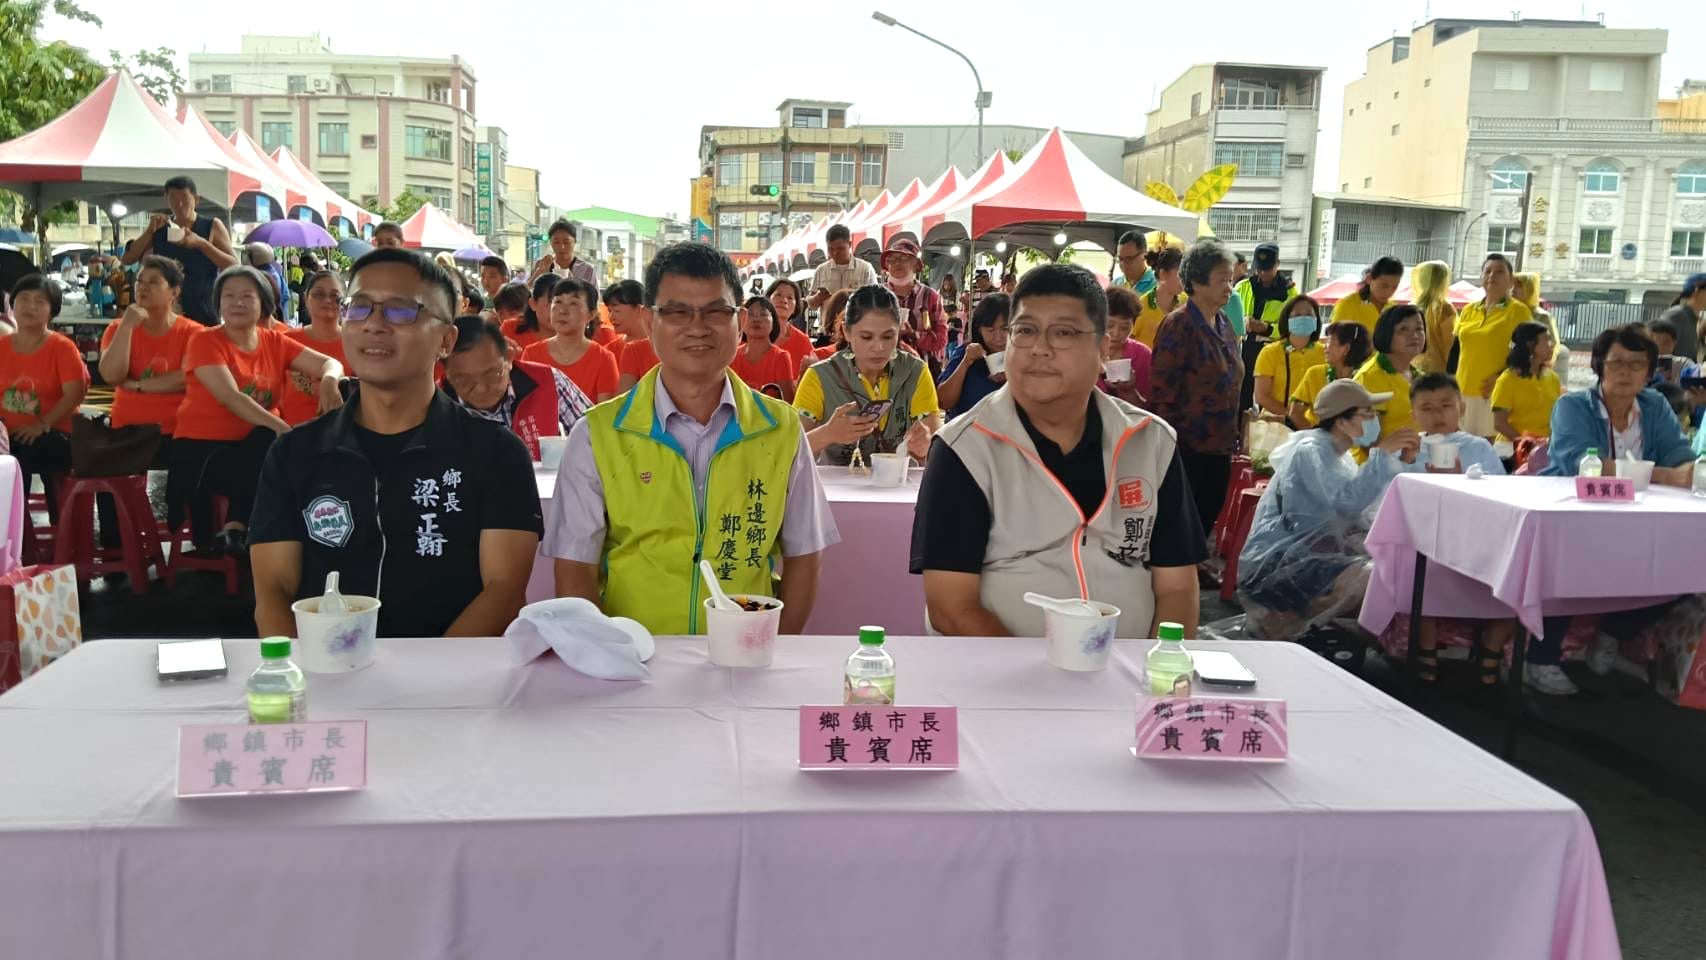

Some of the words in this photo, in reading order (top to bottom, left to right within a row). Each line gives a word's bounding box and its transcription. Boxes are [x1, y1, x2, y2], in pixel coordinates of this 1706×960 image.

[442, 468, 463, 513] 鄉長
[411, 478, 448, 556] 梁正翰
[745, 478, 768, 568] 林邊鄉長
[715, 513, 742, 581] 鄭慶堂
[818, 710, 940, 733] 鄉鎮市長
[1153, 702, 1269, 725] 鄉鎮市長
[202, 727, 346, 754] 鄉鎮市長
[824, 735, 934, 764] 貴賓席
[1159, 726, 1263, 754] 貴賓席
[208, 754, 337, 788] 貴賓席
